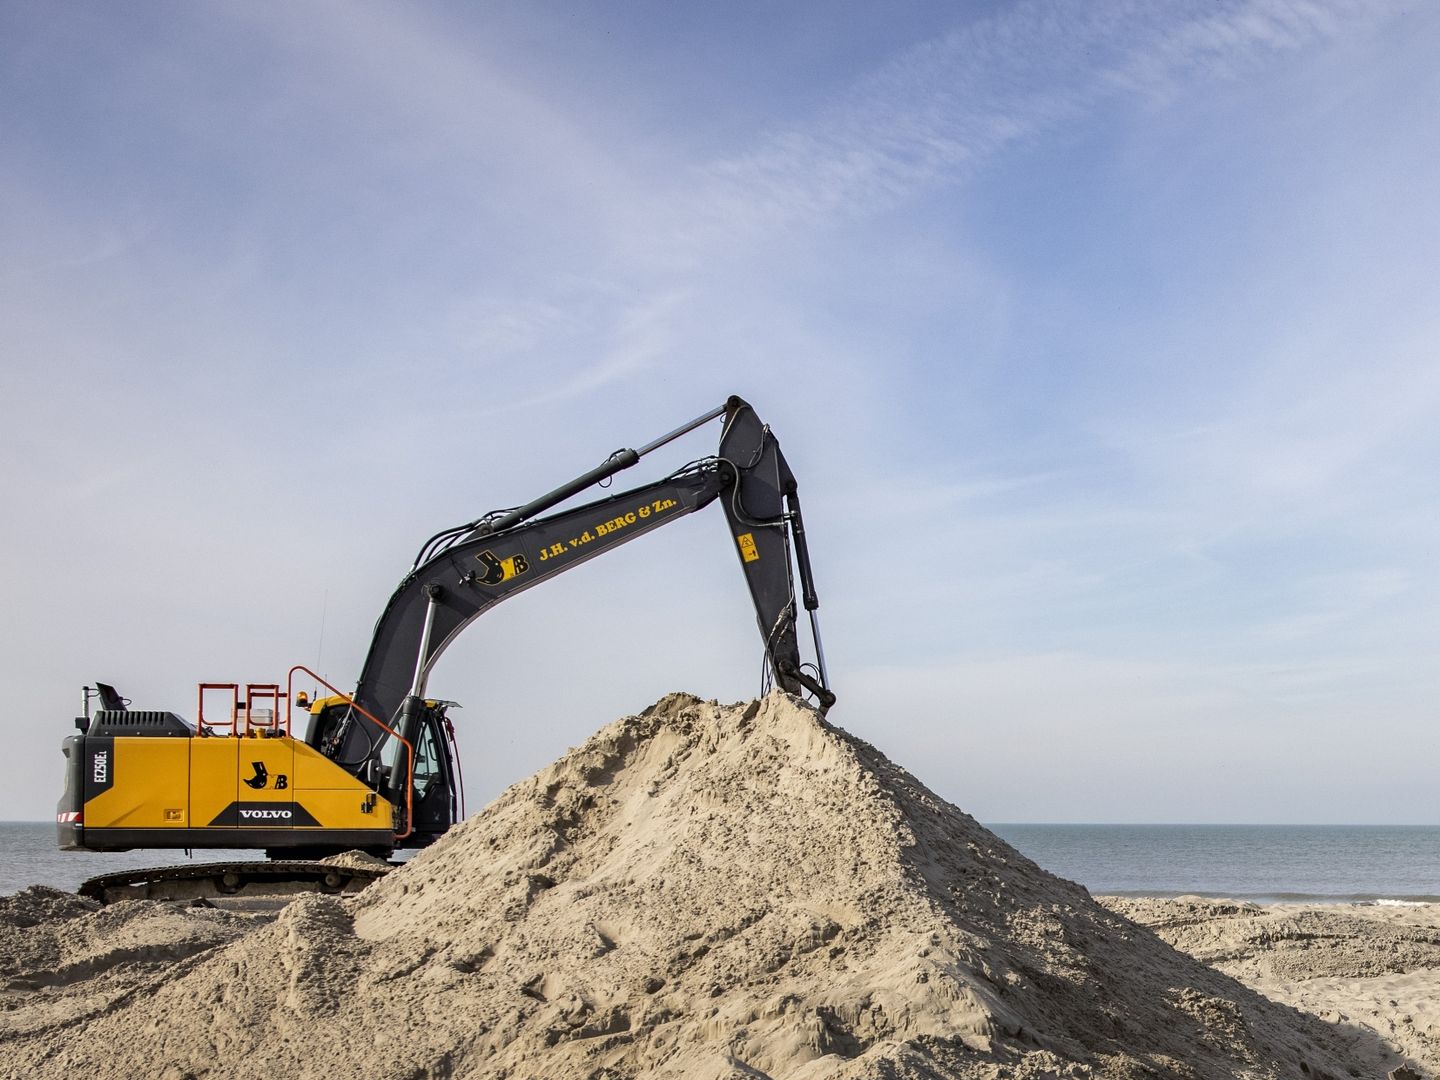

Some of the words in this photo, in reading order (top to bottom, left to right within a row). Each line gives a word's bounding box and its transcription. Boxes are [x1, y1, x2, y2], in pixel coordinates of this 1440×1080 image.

[540, 543, 568, 560] J.H.
[569, 531, 595, 547] v.d.
[595, 512, 637, 537] BERG
[638, 506, 651, 518] &
[652, 499, 677, 513] Zn.
[240, 810, 292, 819] VOLVO
